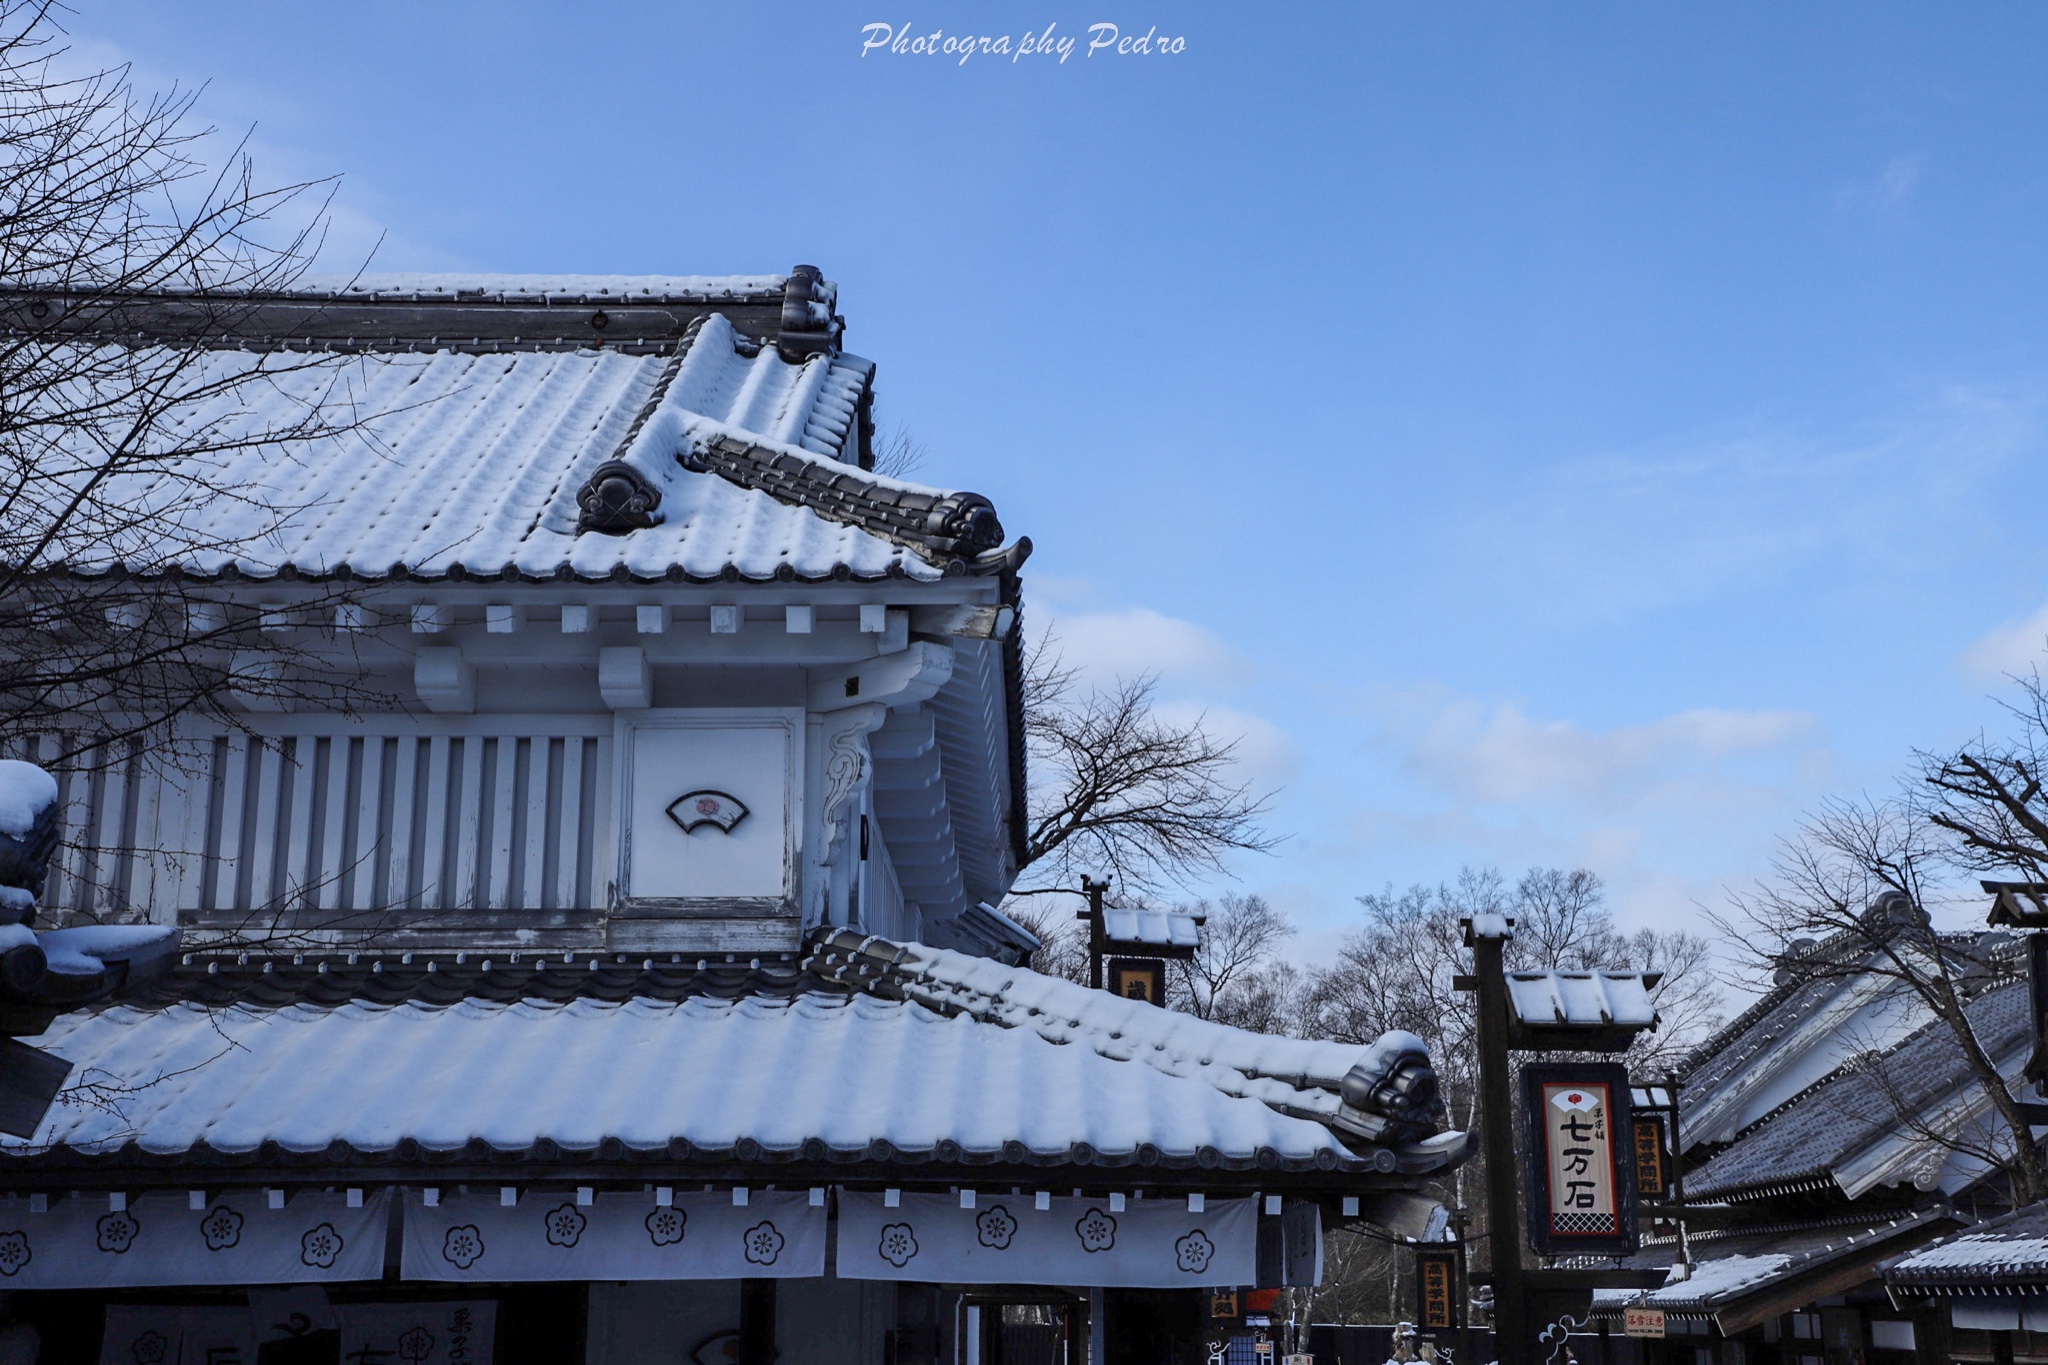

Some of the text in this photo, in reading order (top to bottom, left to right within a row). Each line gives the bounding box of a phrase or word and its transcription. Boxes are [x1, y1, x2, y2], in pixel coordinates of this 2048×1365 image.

[1560, 1114, 1597, 1209] 七万石
[1627, 1314, 1664, 1328] 落雪注意
